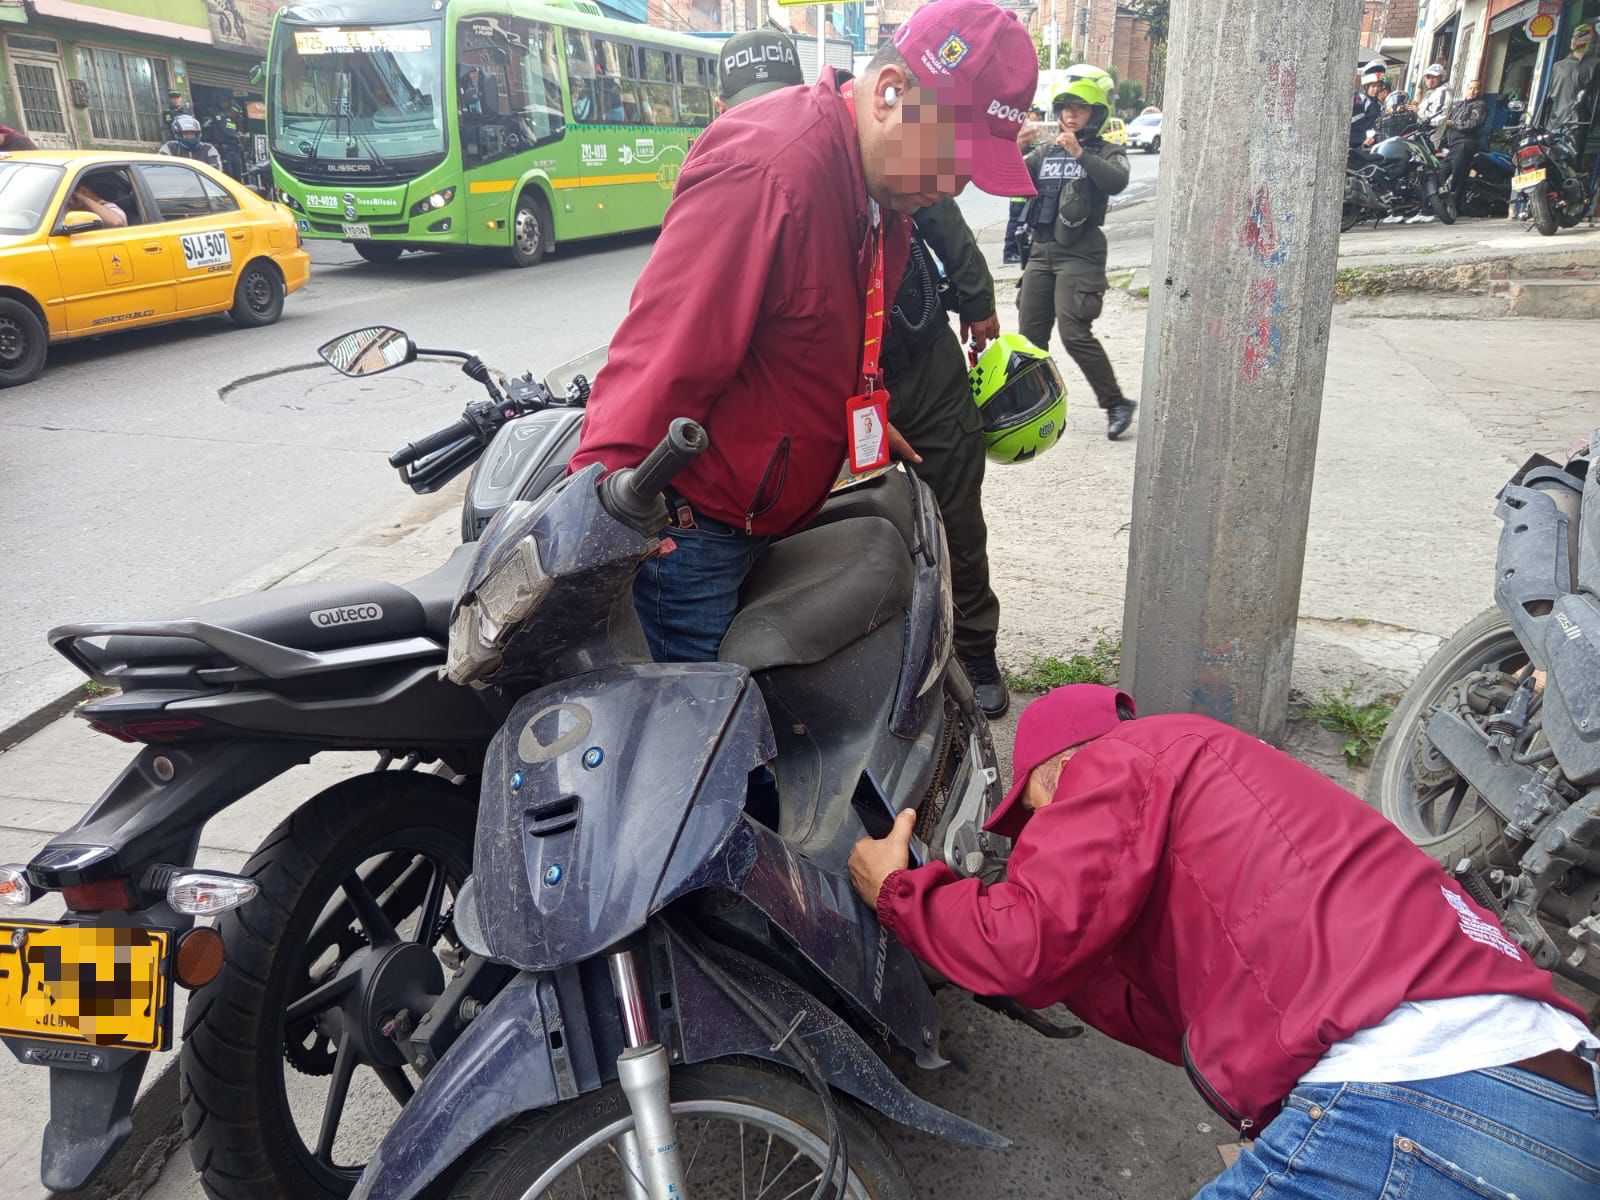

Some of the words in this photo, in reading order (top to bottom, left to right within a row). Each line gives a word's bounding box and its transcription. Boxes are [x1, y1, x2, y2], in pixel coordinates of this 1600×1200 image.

[724, 41, 796, 75] POLICÍA
[328, 164, 371, 172] BUSSCAR
[1042, 161, 1082, 177] POLCÍA
[357, 197, 397, 206] TransMilenio
[182, 232, 228, 261] SIJ-507
[317, 605, 378, 626] auteco
